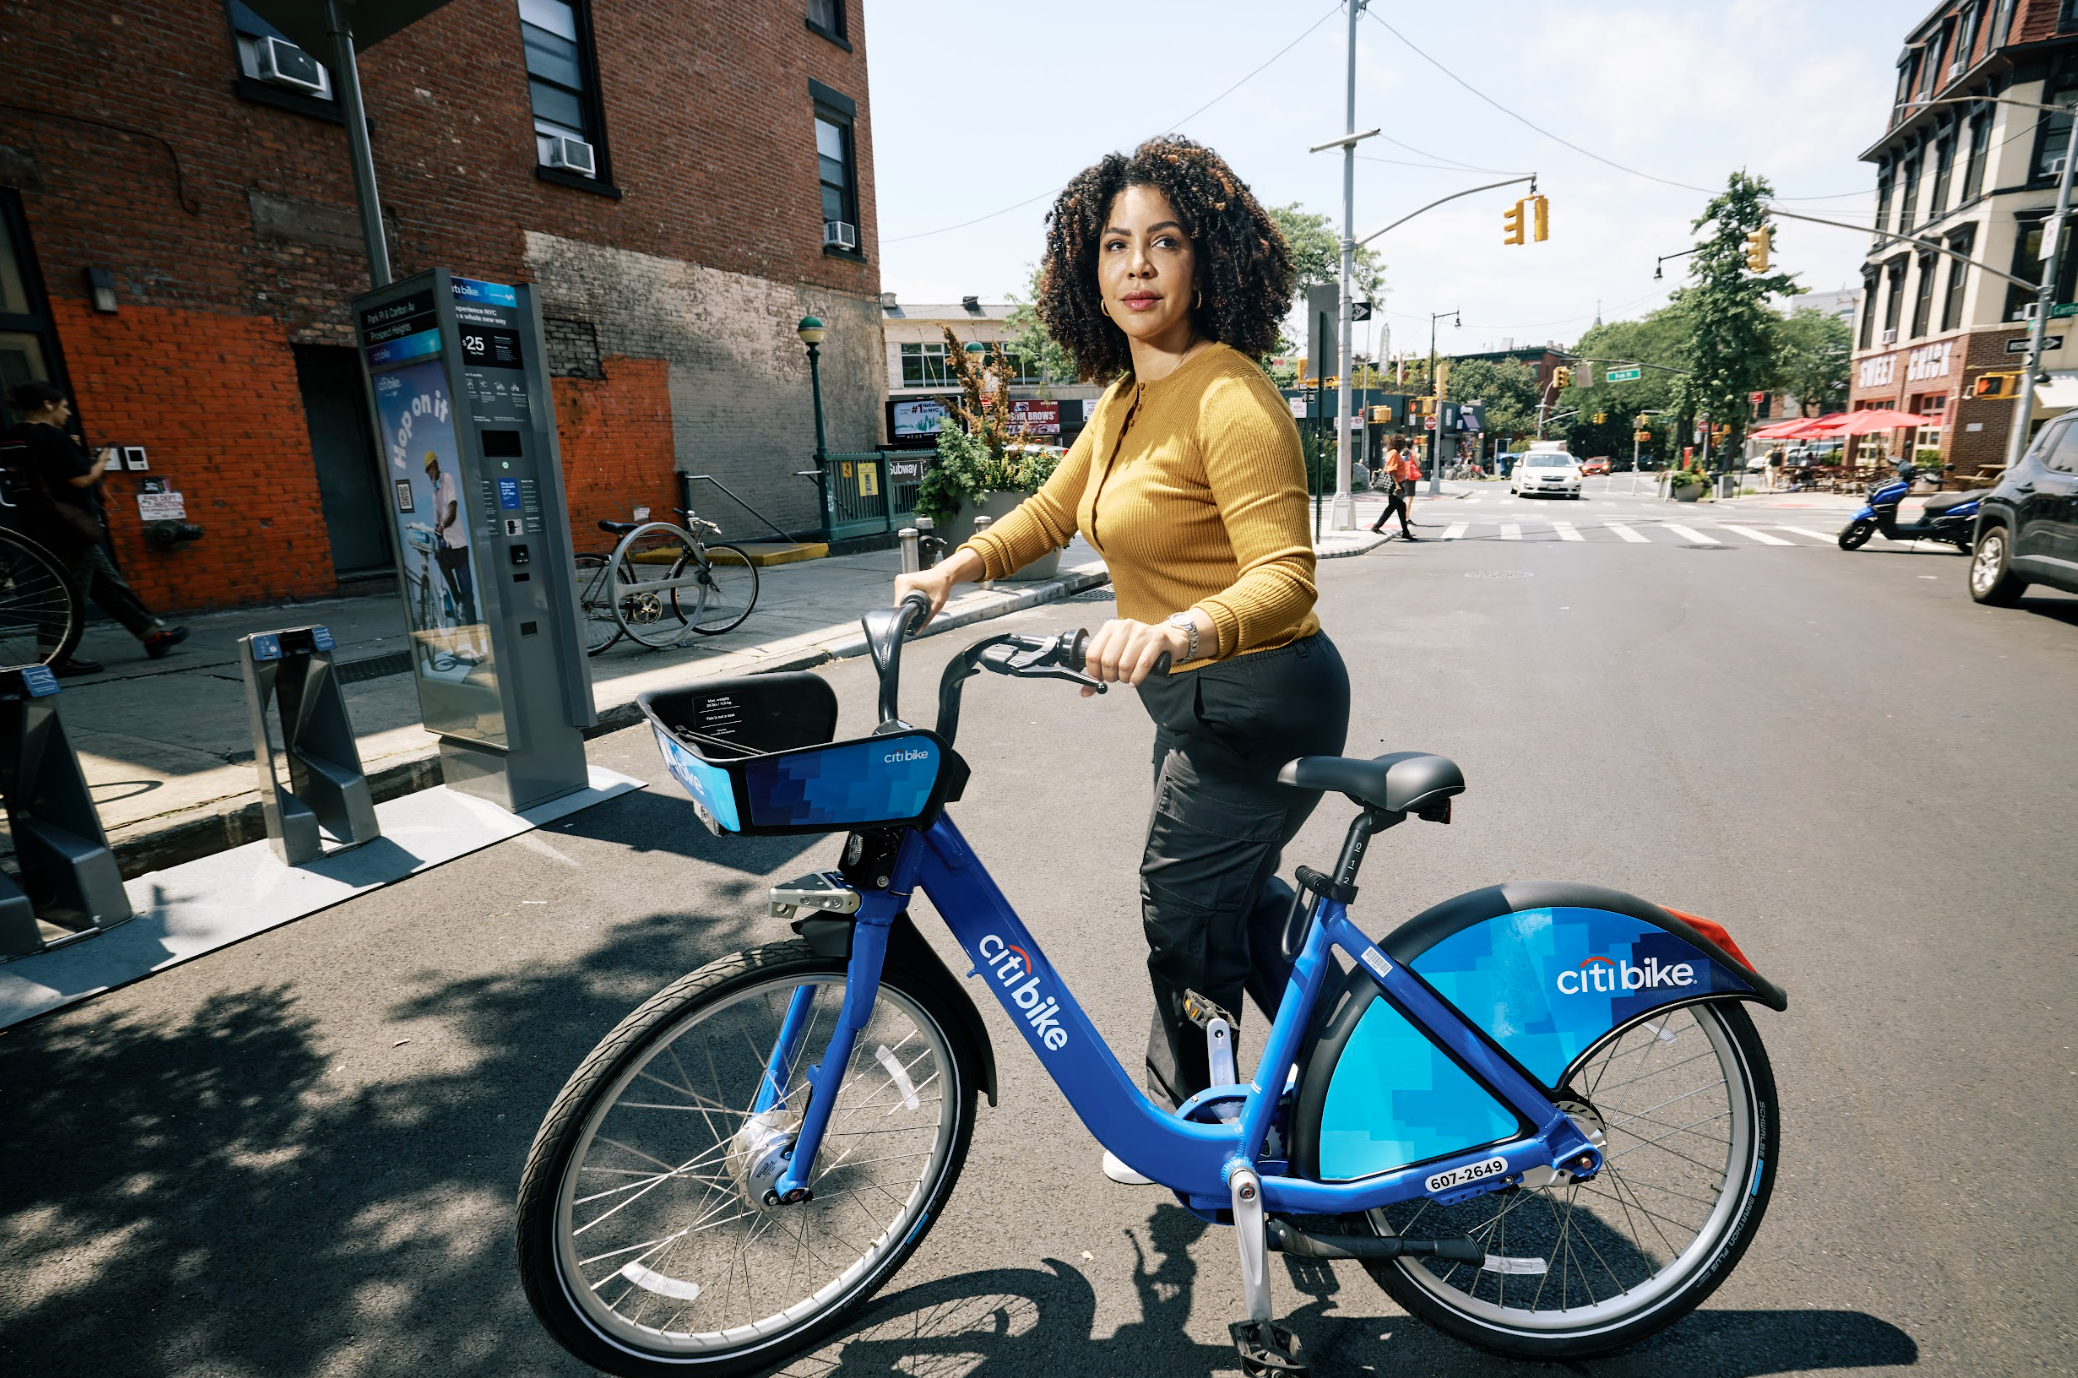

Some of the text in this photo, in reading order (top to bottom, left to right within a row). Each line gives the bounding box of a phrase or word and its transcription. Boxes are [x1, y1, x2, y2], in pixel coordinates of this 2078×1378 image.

[451, 284, 461, 294] iti
[460, 284, 480, 297] bike
[367, 313, 379, 324] Park
[389, 306, 408, 318] Carlton
[455, 306, 484, 316] xperience
[484, 308, 498, 316] NYC
[1352, 307, 1362, 317] AY
[464, 314, 482, 322] whole
[494, 318, 506, 326] way
[370, 322, 412, 342] Prospect Heights
[461, 336, 485, 352] $25
[1858, 340, 1954, 389] SWEET CHICK
[911, 403, 923, 414] #1
[1028, 411, 1055, 420] BROWS
[393, 390, 448, 470] Hop on it
[890, 462, 918, 476] Subway
[884, 749, 928, 764] citi bike
[1556, 956, 1694, 995] citi bike
[979, 934, 1068, 1051] citi bike
[1431, 1160, 1503, 1190] 607-2649
[1710, 1196, 1755, 1273] MARATHON PLUS
